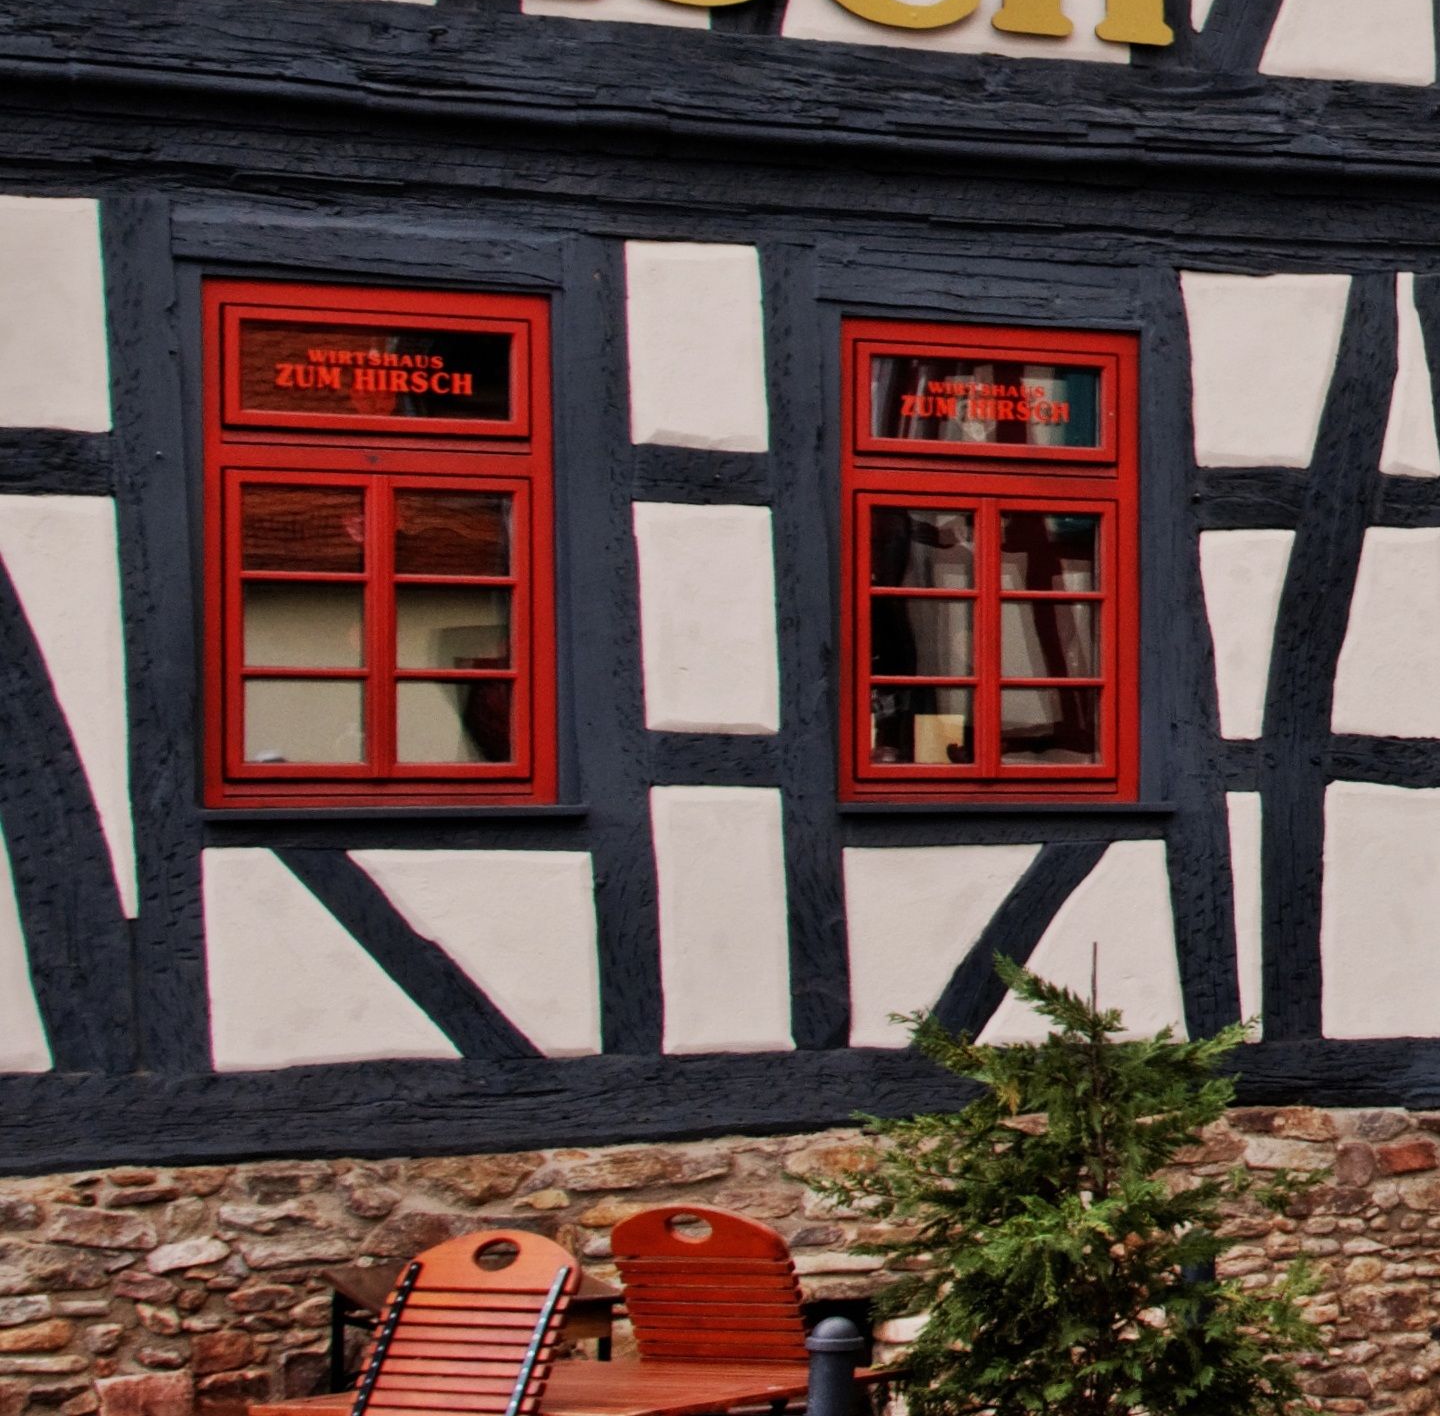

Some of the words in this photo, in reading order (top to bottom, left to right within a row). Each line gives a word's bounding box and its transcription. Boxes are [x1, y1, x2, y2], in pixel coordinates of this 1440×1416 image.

[307, 349, 444, 369] WIRTSHAUS
[275, 363, 341, 389] ZUM
[354, 368, 473, 395] HIRSCH
[927, 380, 1045, 398] WIRTSHAUS
[901, 395, 957, 418] ZUM
[967, 398, 1070, 423] HIRSCH
